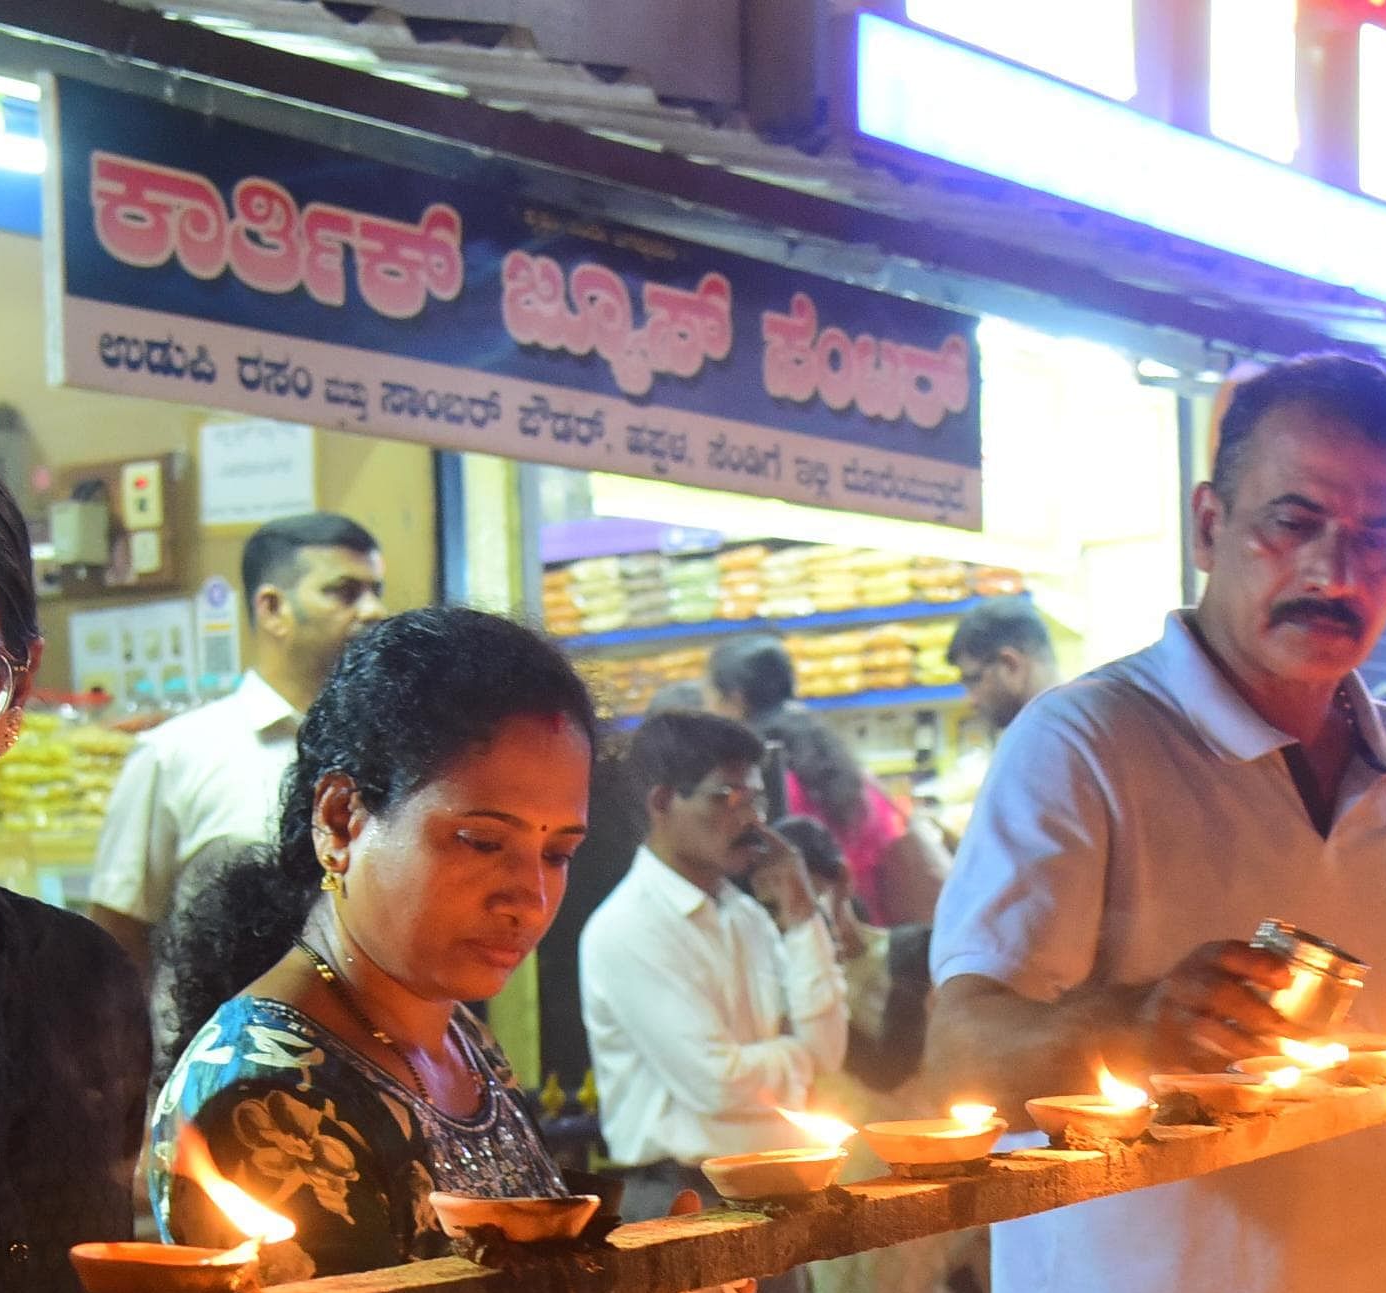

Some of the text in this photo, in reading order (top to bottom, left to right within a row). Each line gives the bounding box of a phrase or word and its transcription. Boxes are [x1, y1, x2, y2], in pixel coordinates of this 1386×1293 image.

[89, 150, 464, 320] ಕಾರ್ತಿಕ್
[99, 329, 217, 388] ಉಡುಪಿ
[236, 352, 313, 399] ರಸಂ
